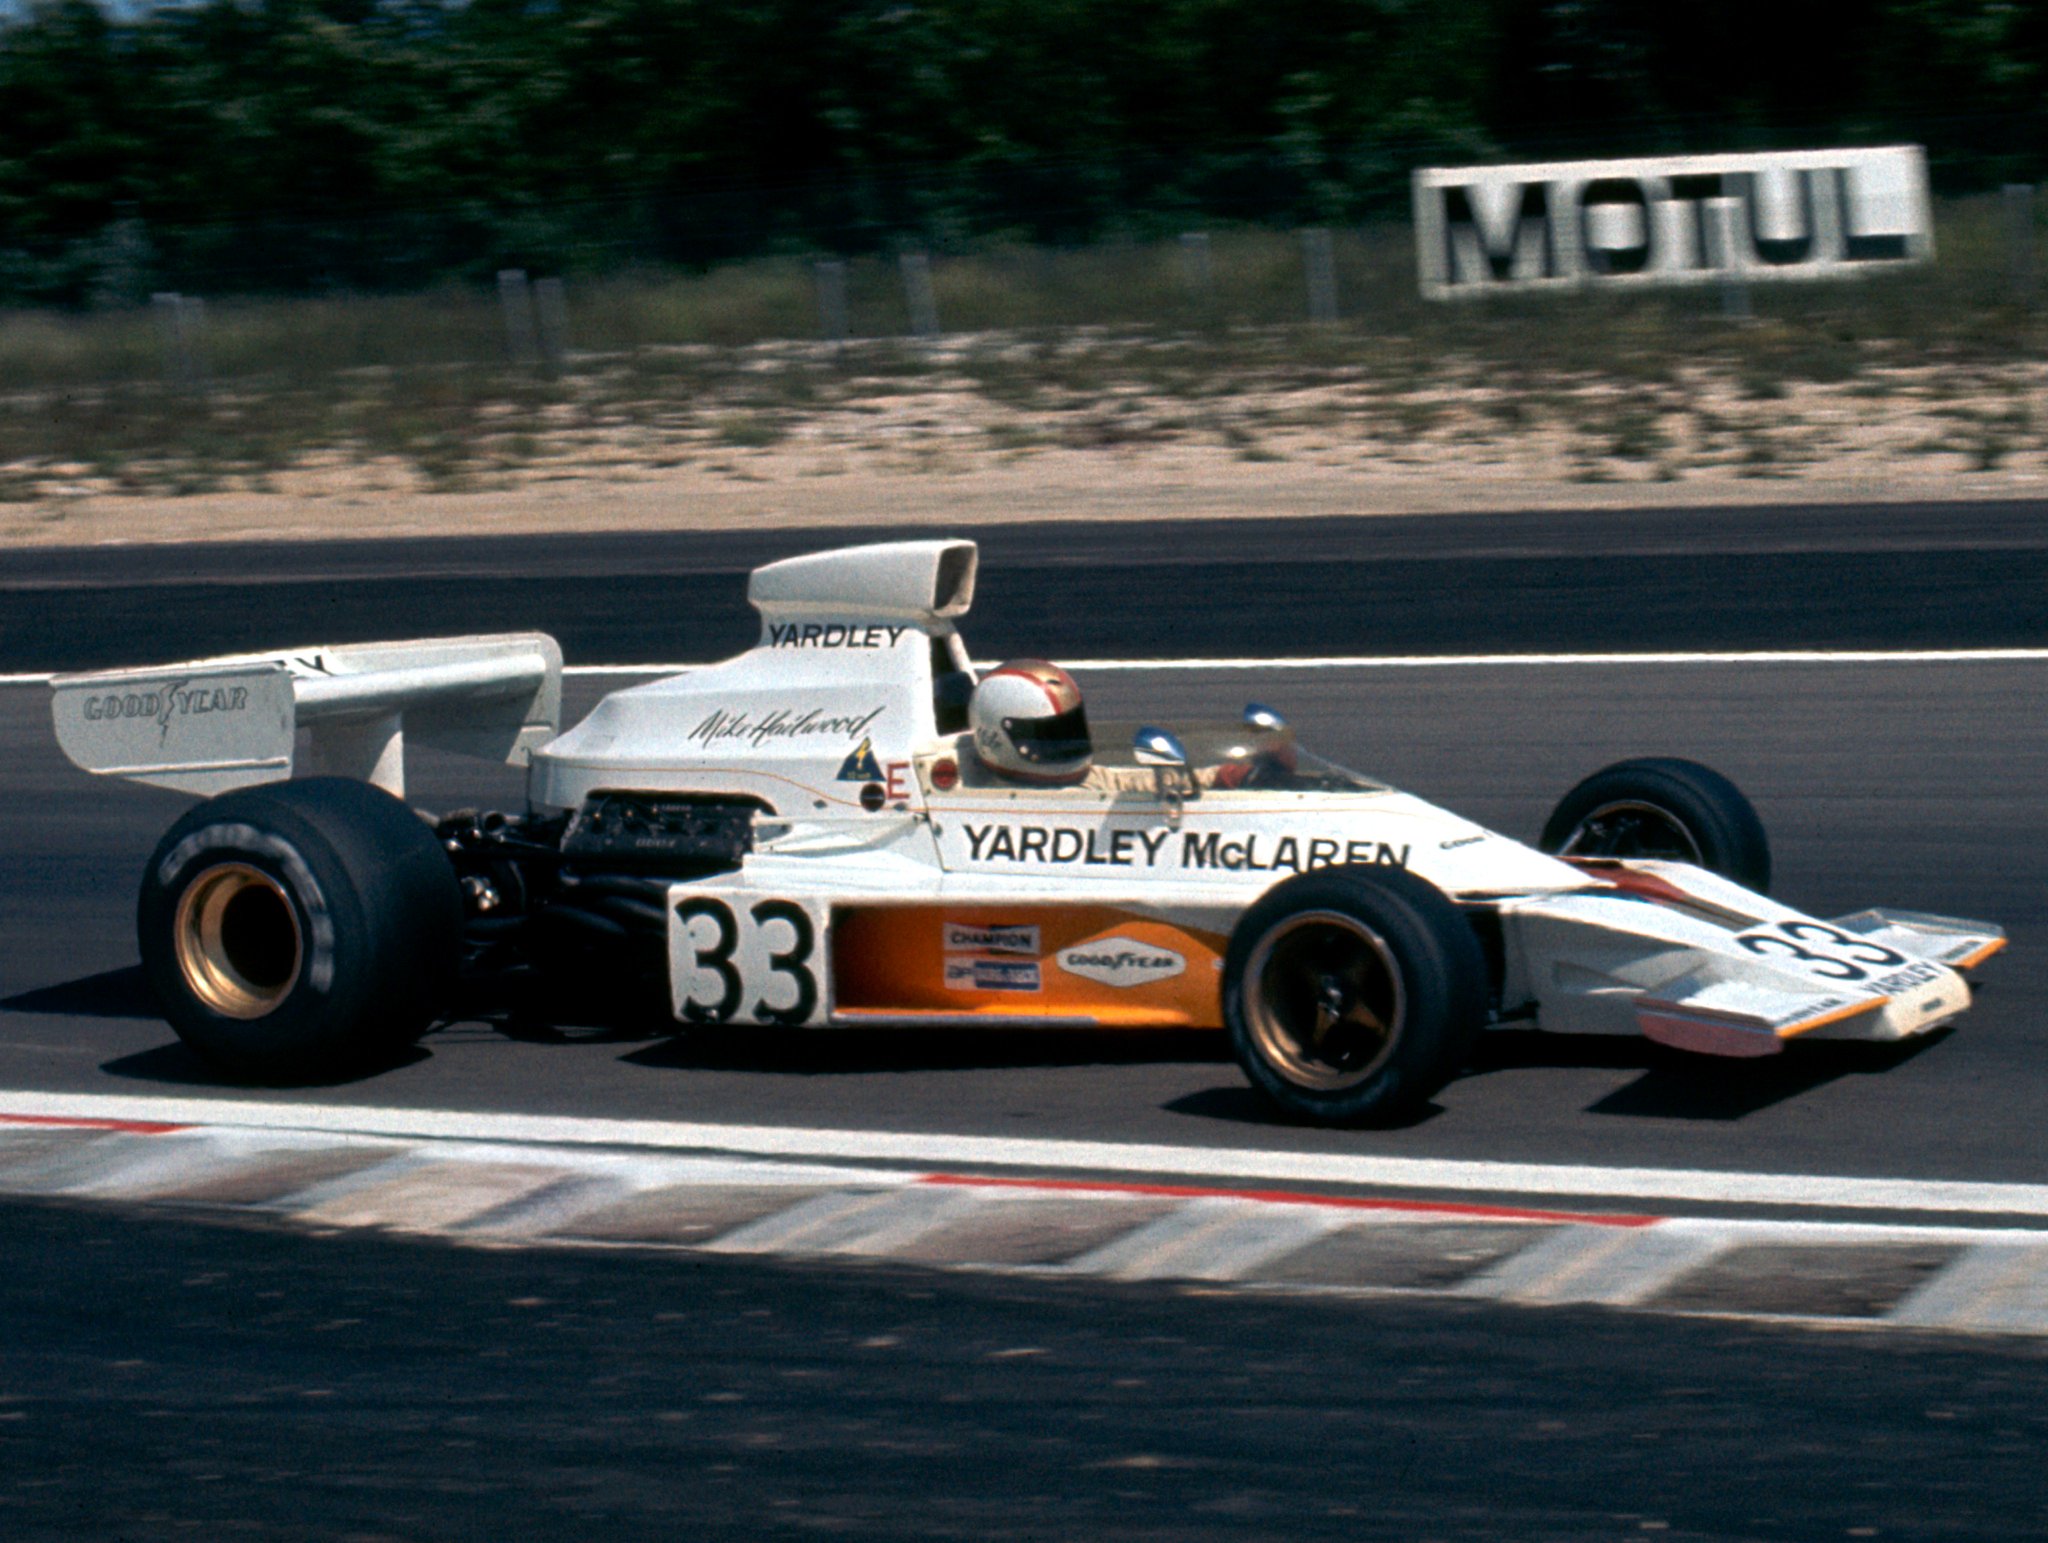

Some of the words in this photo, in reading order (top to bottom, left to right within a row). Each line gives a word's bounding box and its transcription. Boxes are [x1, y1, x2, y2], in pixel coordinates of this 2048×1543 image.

[1441, 166, 1911, 286] MOTUL
[768, 623, 908, 648] YARDLEY
[688, 708, 750, 749] Mike
[750, 704, 886, 748] Hailwood
[886, 762, 910, 799] E
[963, 824, 1168, 868] YARDLEY
[1180, 831, 1411, 873] McLAREN
[674, 896, 818, 1024] 33
[951, 931, 1032, 948] CHAMPION
[1734, 920, 1907, 981] 33
